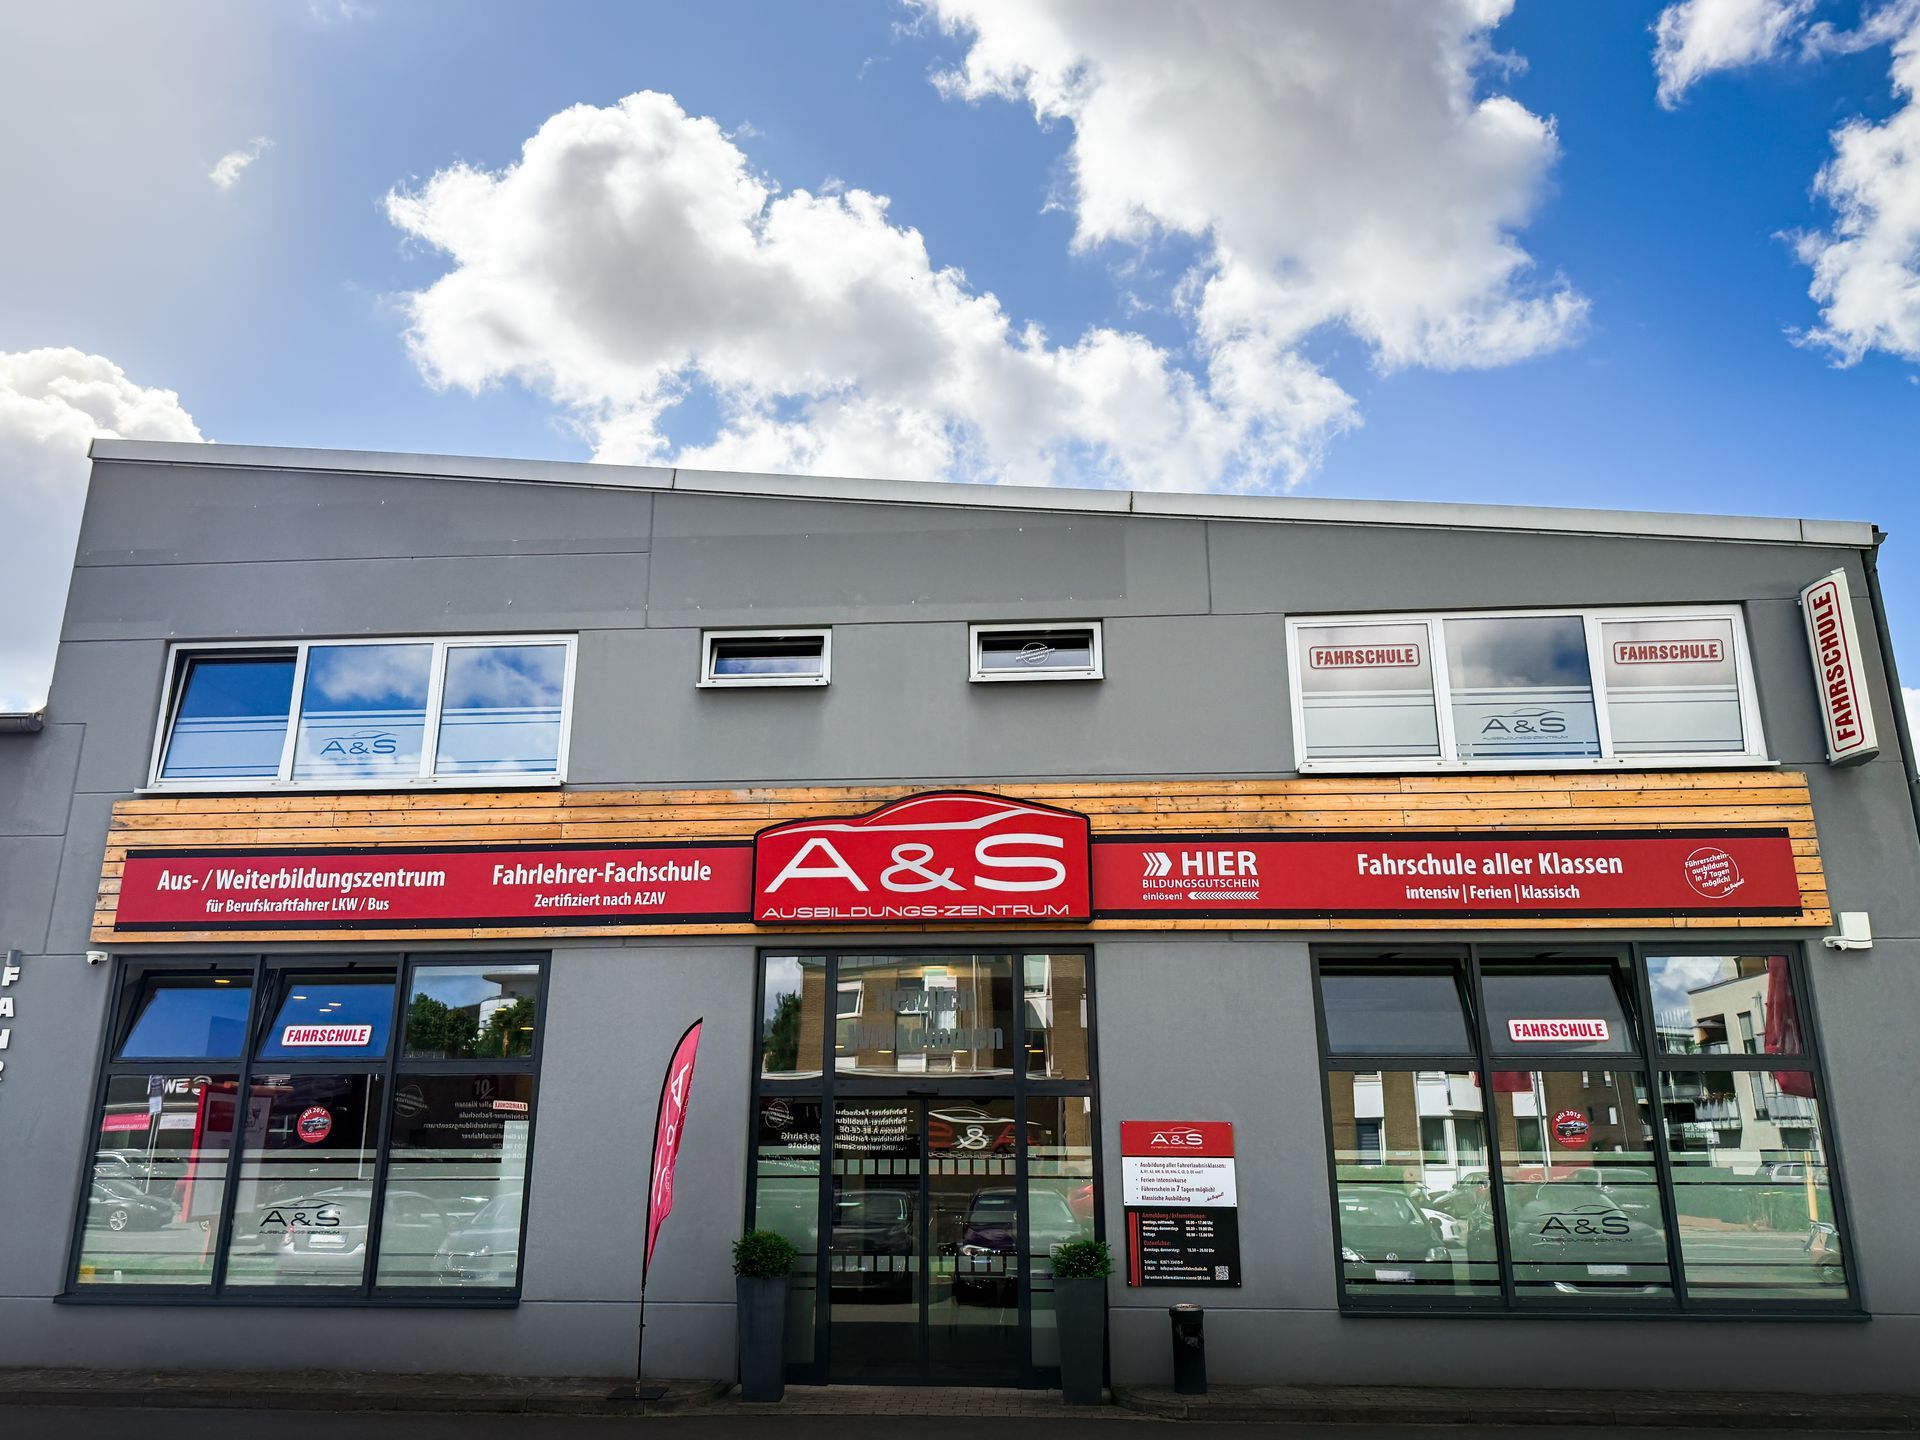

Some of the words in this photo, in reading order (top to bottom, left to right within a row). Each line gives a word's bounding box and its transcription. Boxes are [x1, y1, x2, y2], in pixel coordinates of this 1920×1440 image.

[1315, 648, 1414, 665] FAHRSCHULE
[1619, 644, 1718, 660] FAHRSCHULE
[1812, 591, 1857, 741] FAHRSCHULE
[1181, 851, 1258, 876] HIER
[1357, 852, 1477, 876] Fahrschule
[1482, 852, 1533, 876] aller
[1538, 852, 1623, 875] Klassen
[1691, 860, 1729, 875] ausbildung
[157, 869, 199, 890] Aus-
[215, 867, 446, 893] Weiterbildungszentrum
[492, 860, 712, 886] Fahrlehrer-Fachschule
[1709, 868, 1730, 879] Tagen
[1142, 878, 1260, 889] BILDUNGSGUTSCHEIN
[1142, 892, 1183, 901] einlösen!
[1470, 884, 1511, 899] Ferien
[1521, 884, 1580, 899] klassisch
[206, 898, 224, 913] für
[225, 897, 330, 913] Berufskraftfahrer
[331, 897, 358, 912] LKW
[367, 897, 389, 911] Bus
[534, 893, 600, 908] Zertifiziert
[602, 891, 631, 906] nach
[633, 891, 666, 906] AZAV
[762, 904, 1069, 919] AUSBILDUNGS-ZENTRUM
[286, 1029, 367, 1042] FAHRSCHULE
[1513, 1023, 1605, 1037] FAHRSCHULE
[1565, 1110, 1582, 1119] 2015
